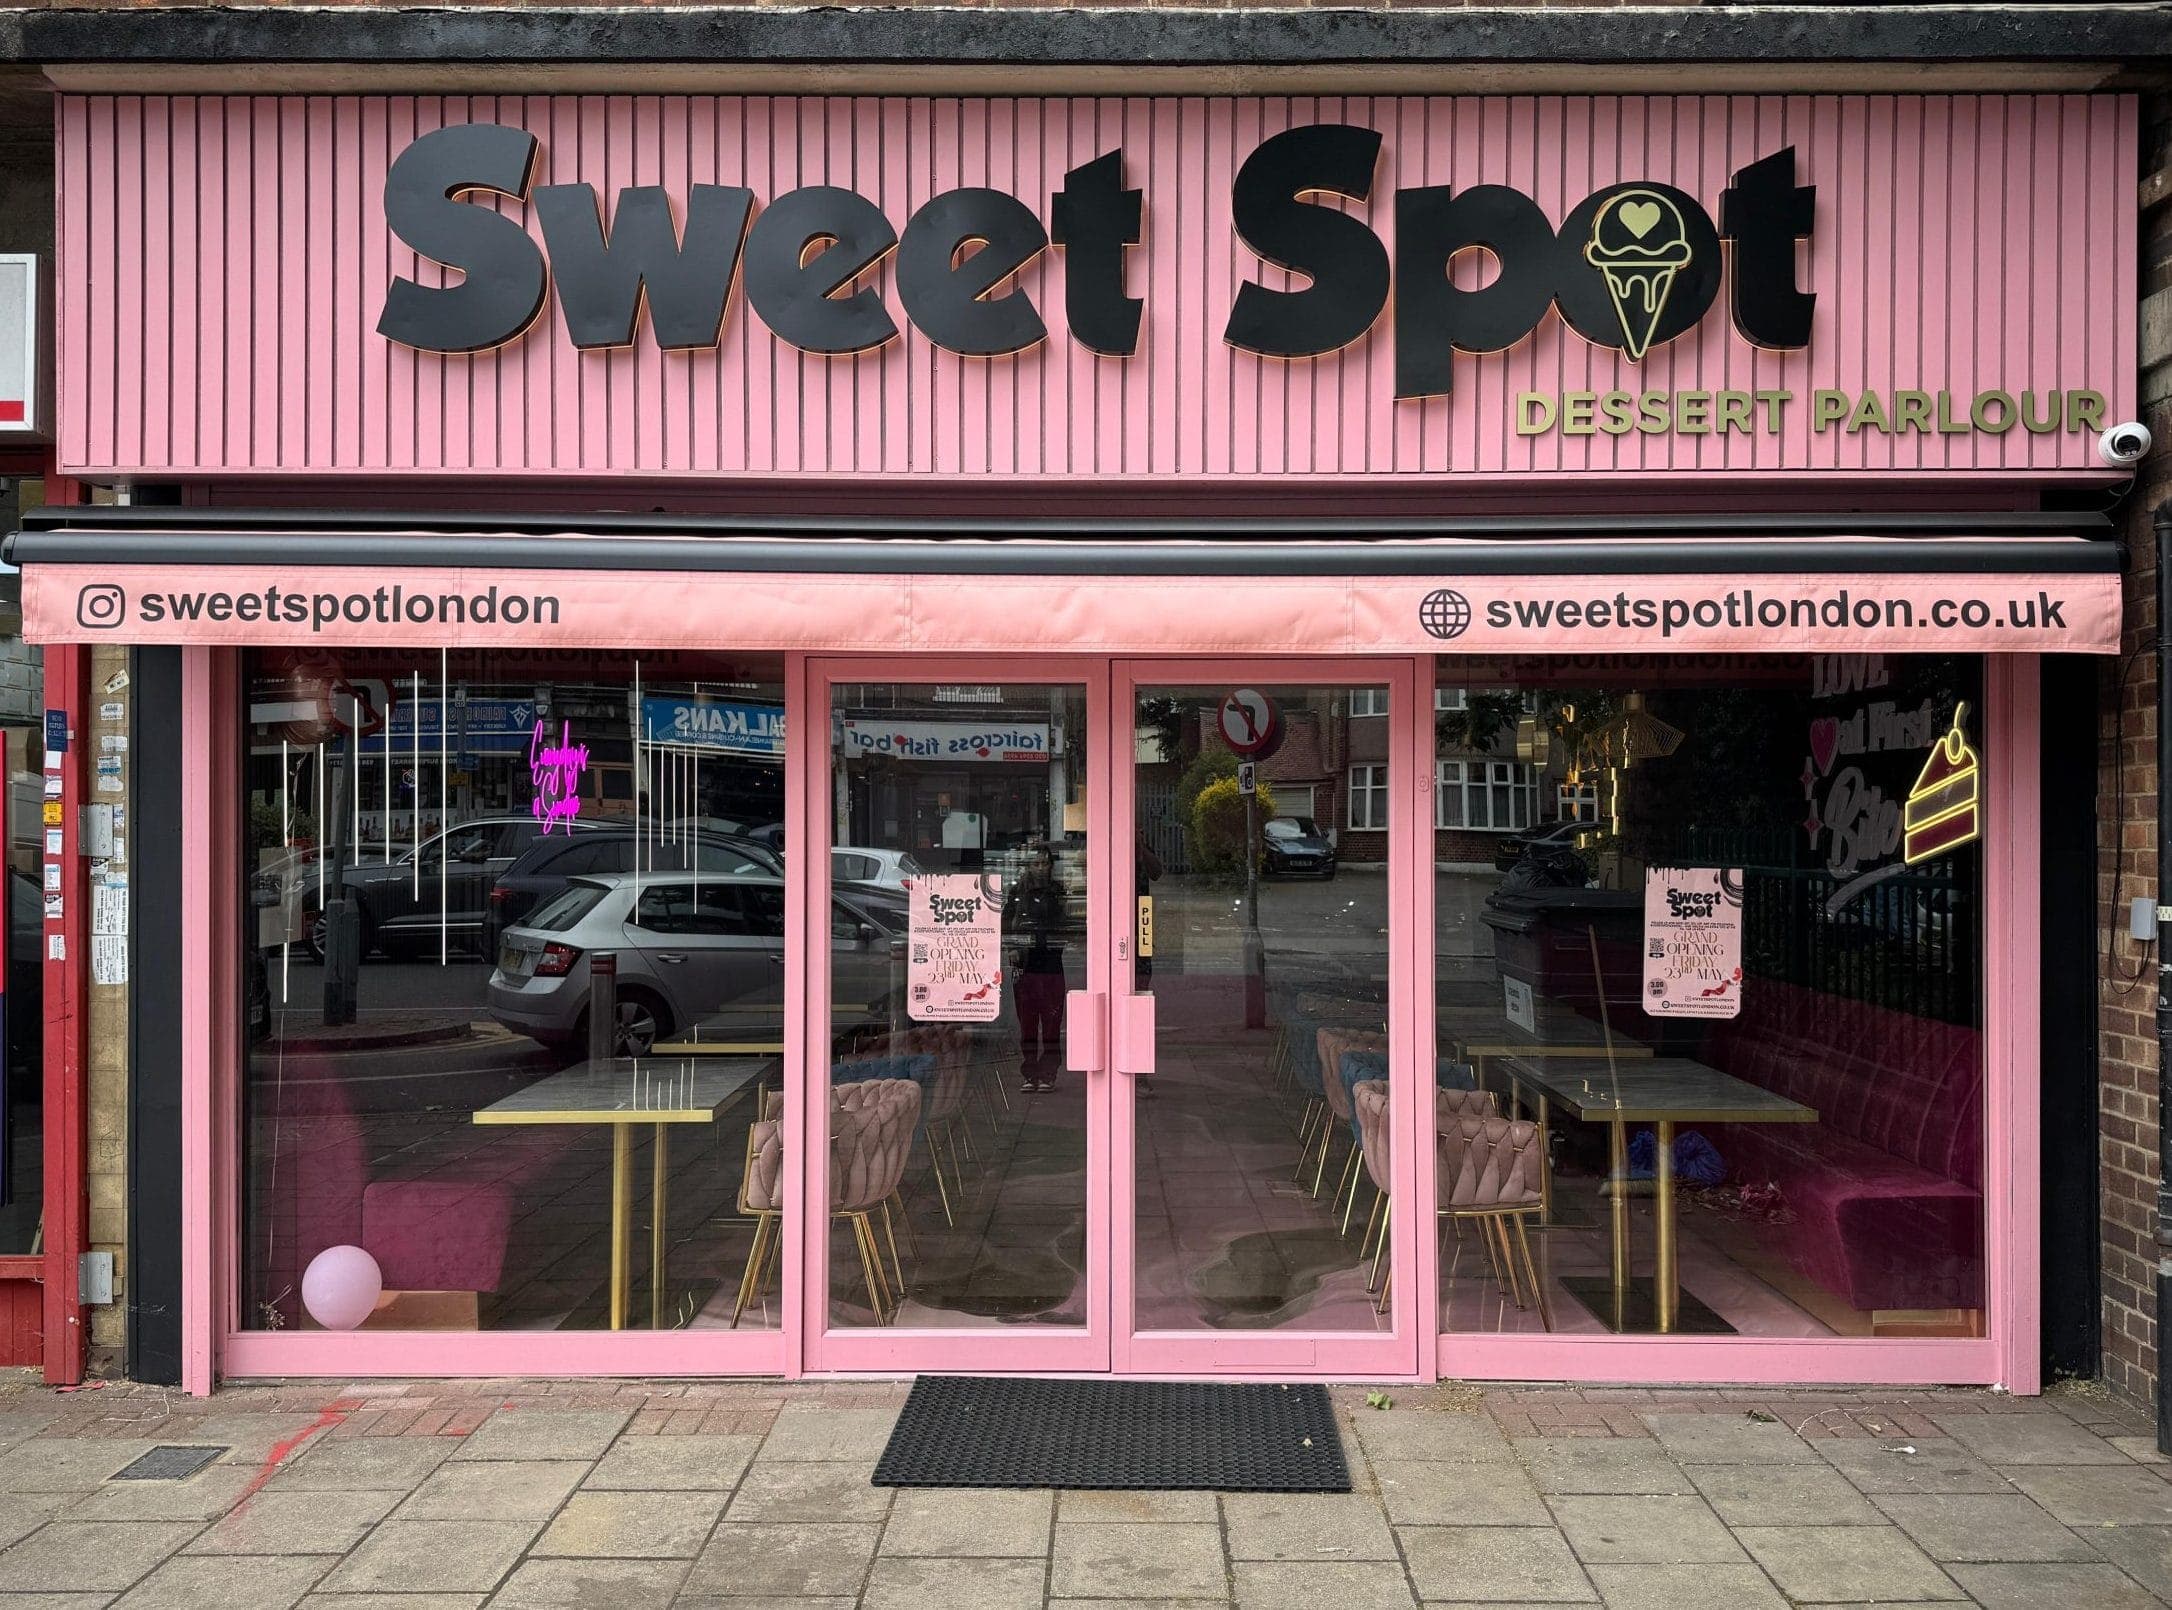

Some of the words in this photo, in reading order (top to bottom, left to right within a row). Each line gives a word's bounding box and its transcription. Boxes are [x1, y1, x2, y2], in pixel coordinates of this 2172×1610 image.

[376, 123, 1144, 357] Sweet
[1222, 123, 1817, 403] Spot
[1516, 389, 1792, 437] DESSERT
[1814, 388, 2107, 435] PARLOUR
[139, 586, 560, 631] sweetspotlondon
[1486, 590, 2067, 637] sweetspotlondon.co.uk
[929, 894, 982, 911] Sweet
[1666, 888, 1722, 905] Sweet
[934, 909, 974, 925] Spot
[1670, 903, 1713, 920] Spot
[936, 936, 979, 949] GRAND
[1673, 931, 1718, 944] GRAND
[930, 949, 985, 961] OPENING
[1666, 943, 1724, 956] OPENING
[936, 960, 978, 972] FRIDAY
[1672, 955, 1717, 968] FRIDAY
[960, 972, 984, 984] MAY
[1697, 968, 1724, 980] MAY
